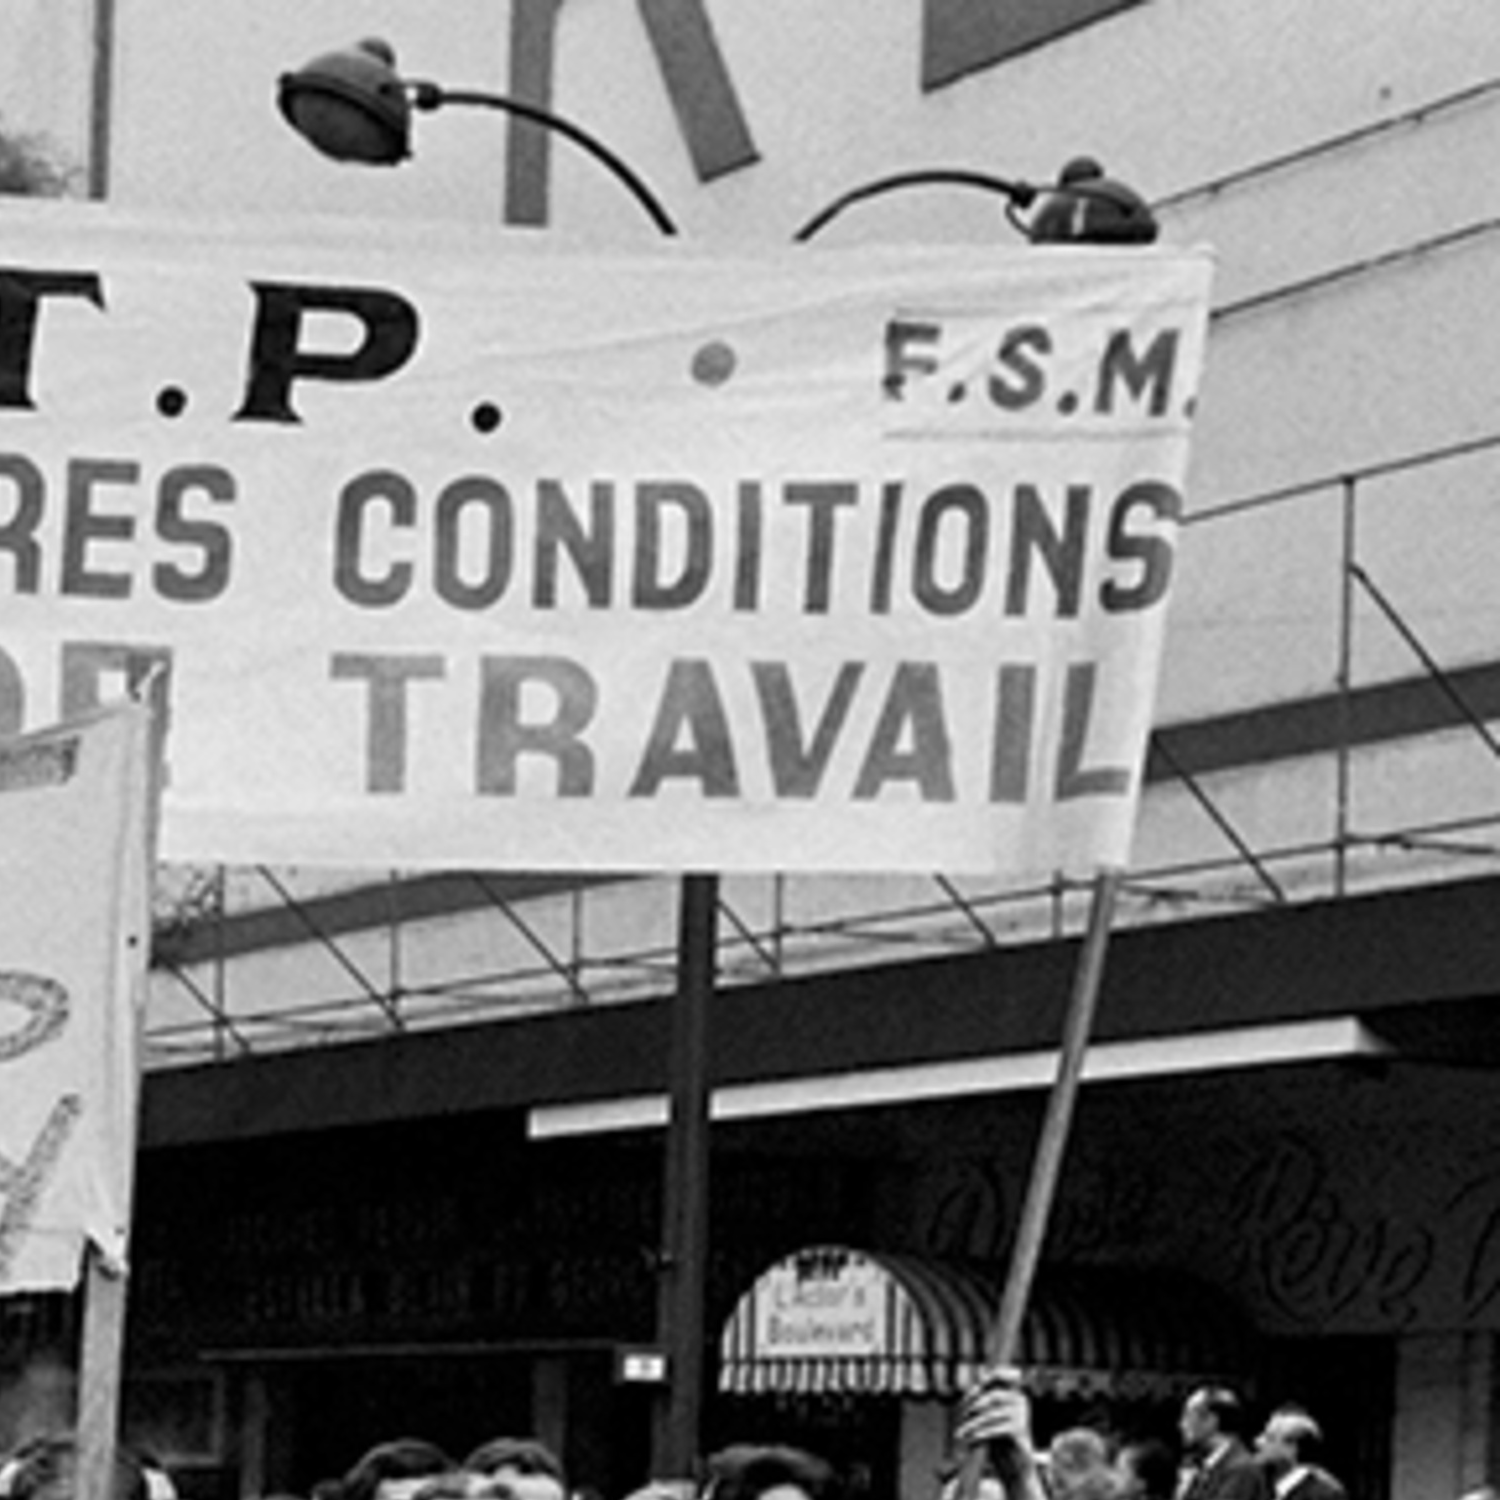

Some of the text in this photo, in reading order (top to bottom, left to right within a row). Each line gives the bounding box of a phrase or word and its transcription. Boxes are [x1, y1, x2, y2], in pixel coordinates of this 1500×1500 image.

[882, 320, 1198, 418] F.S.M.
[332, 469, 1184, 619] CONDITIONS
[329, 651, 1131, 803] TRAVAIL
